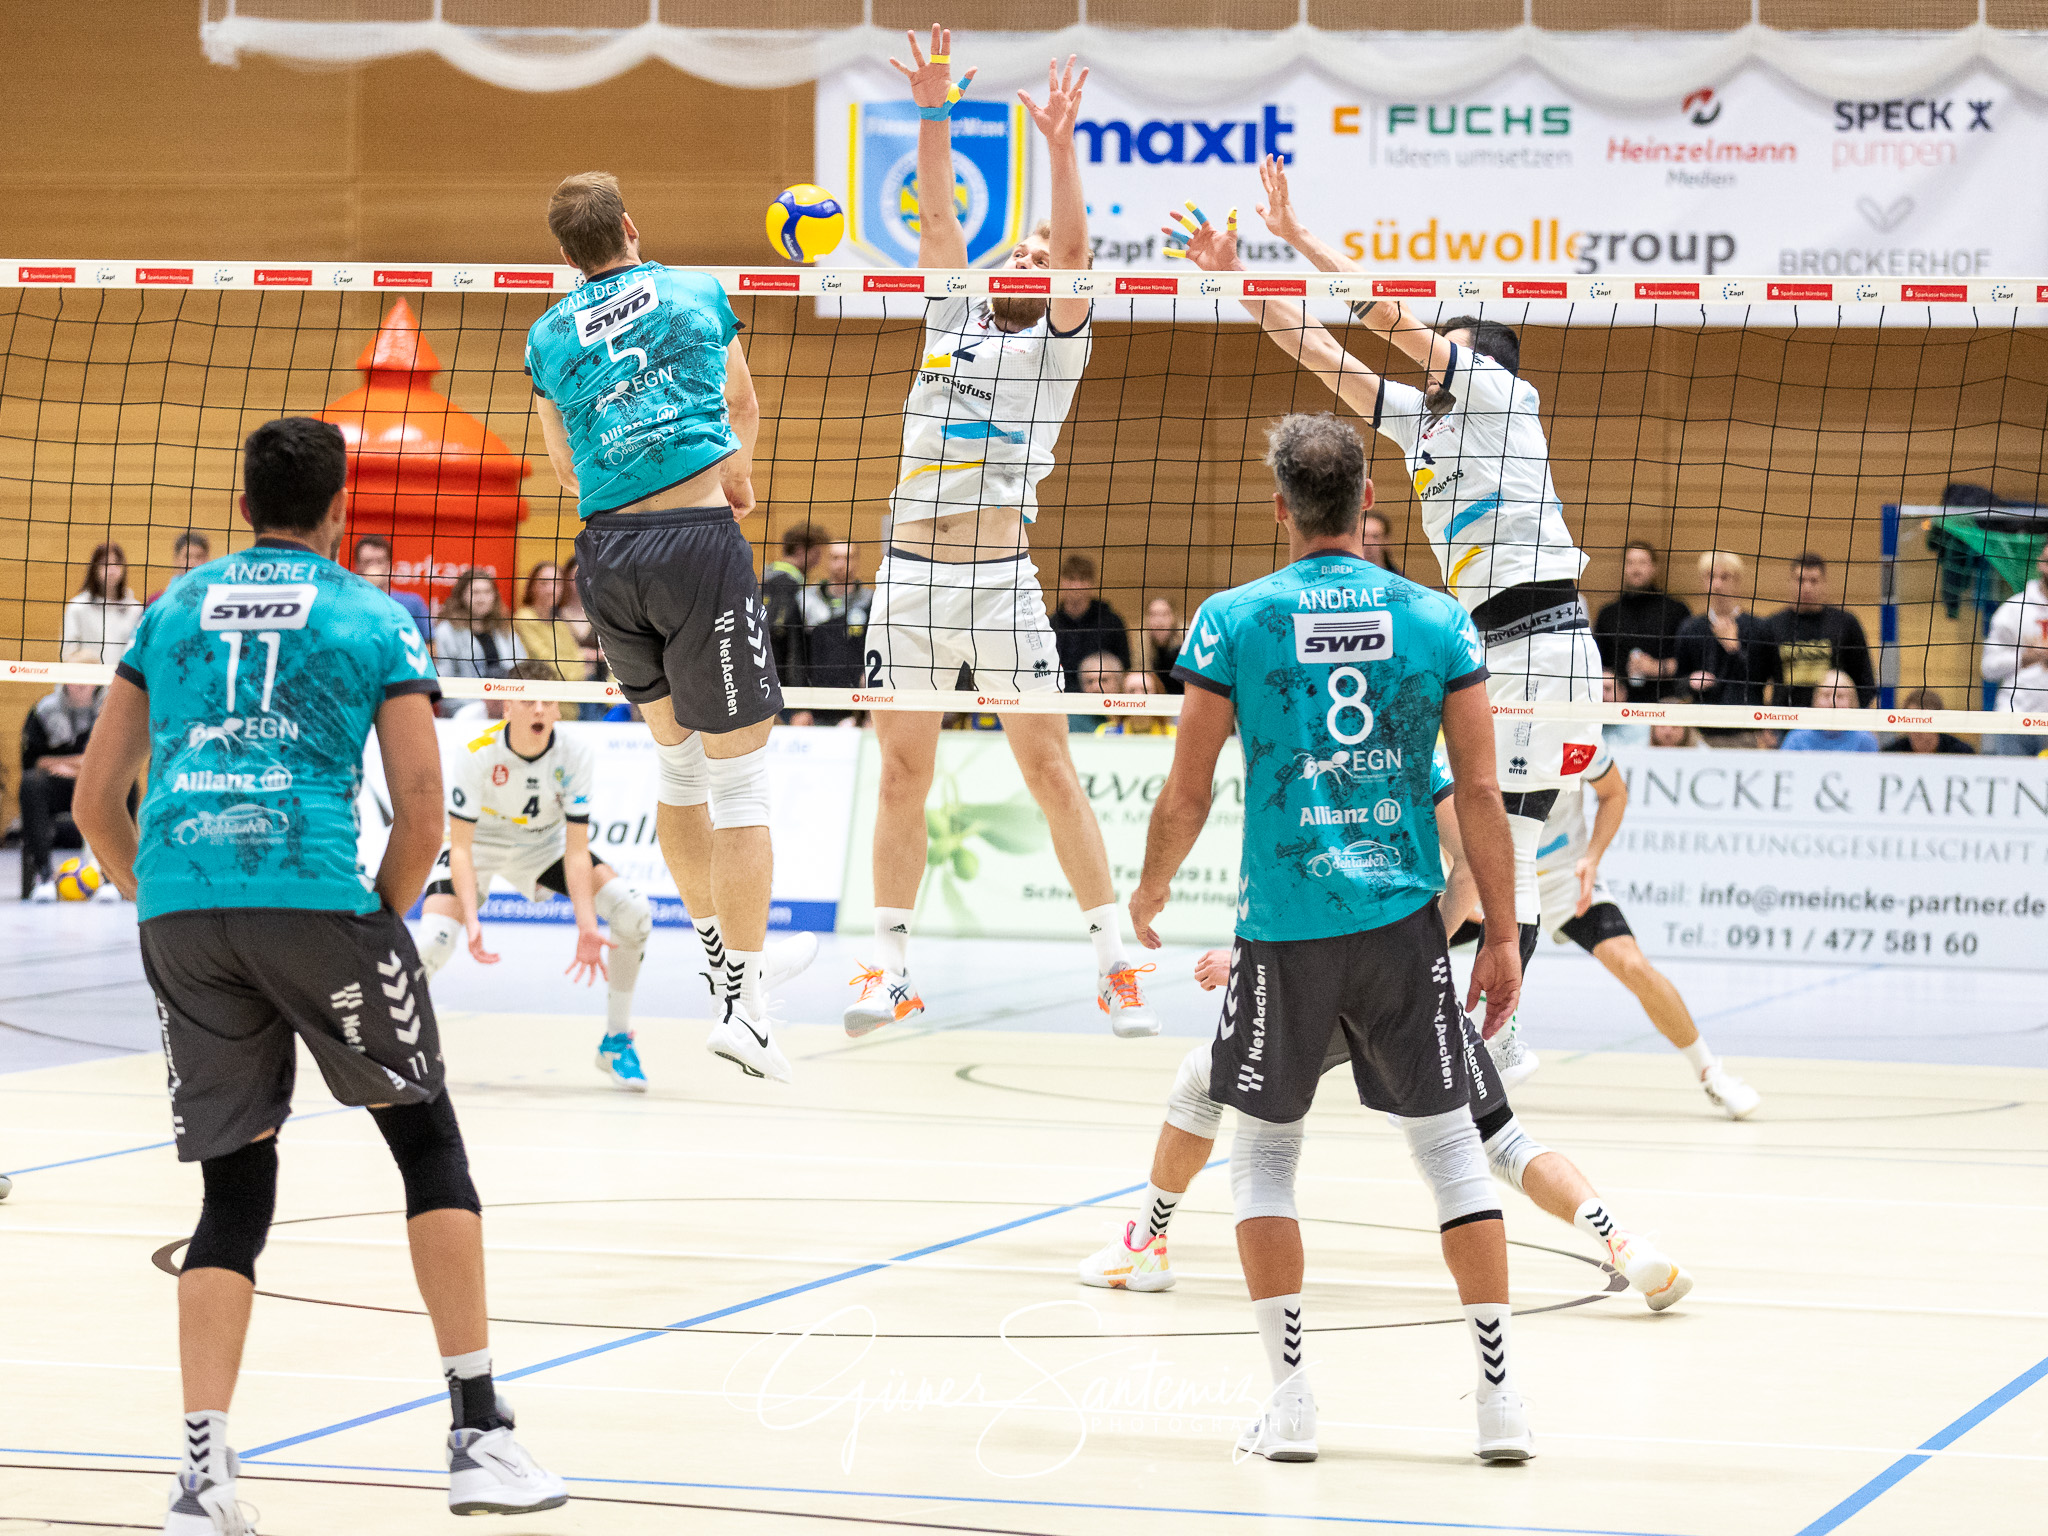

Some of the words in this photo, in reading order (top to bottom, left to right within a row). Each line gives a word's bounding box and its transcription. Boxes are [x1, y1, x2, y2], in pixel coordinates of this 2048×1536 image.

[1388, 105, 1571, 135] FUCHS
[1834, 99, 1955, 132] SPECK
[1074, 104, 1293, 164] maxit
[1607, 137, 1798, 164] Heinzelmann
[1832, 138, 1957, 171] pumpen
[557, 290, 589, 316] VAN
[593, 275, 630, 301] DER
[827, 281, 842, 289] Zapf
[1079, 284, 1094, 292] Zapf
[1206, 285, 1221, 293] Zapf
[1335, 286, 1350, 294] Zapf
[1596, 289, 1611, 297] Zapf
[1862, 291, 1878, 299] Zapf
[1997, 291, 2014, 299] Zapf
[585, 292, 651, 338] SWD
[605, 324, 648, 373] 5
[633, 366, 674, 393] EGN
[221, 563, 318, 582] ANDREI
[1298, 587, 1388, 610] ANDRAE
[209, 603, 301, 620] SWD
[1304, 633, 1386, 654] SWD
[219, 631, 281, 712] 11
[719, 638, 739, 717] NetAachen
[866, 649, 884, 688] 2
[491, 683, 525, 692] Marmot
[760, 676, 771, 699] 5
[861, 695, 894, 703] Marmot
[986, 697, 1020, 706] Marmot
[1112, 700, 1147, 709] Marmot
[1326, 666, 1374, 745] 8
[1499, 706, 1534, 715] Marmot
[1631, 709, 1666, 718] Marmot
[1763, 712, 1799, 721] Marmot
[1897, 715, 1933, 724] Marmot
[243, 717, 299, 741] EGN
[1352, 748, 1402, 772] EGN
[171, 770, 257, 793] Allianz
[1815, 771, 1853, 814] &
[522, 795, 541, 818] 4
[1300, 806, 1369, 827] Allianz
[1727, 925, 1793, 950] 0911
[1824, 928, 1874, 952] 477
[1885, 929, 1933, 954] 581
[1944, 931, 1979, 957] 60
[1248, 964, 1267, 1062] NetAachen
[408, 1050, 429, 1081] 11
